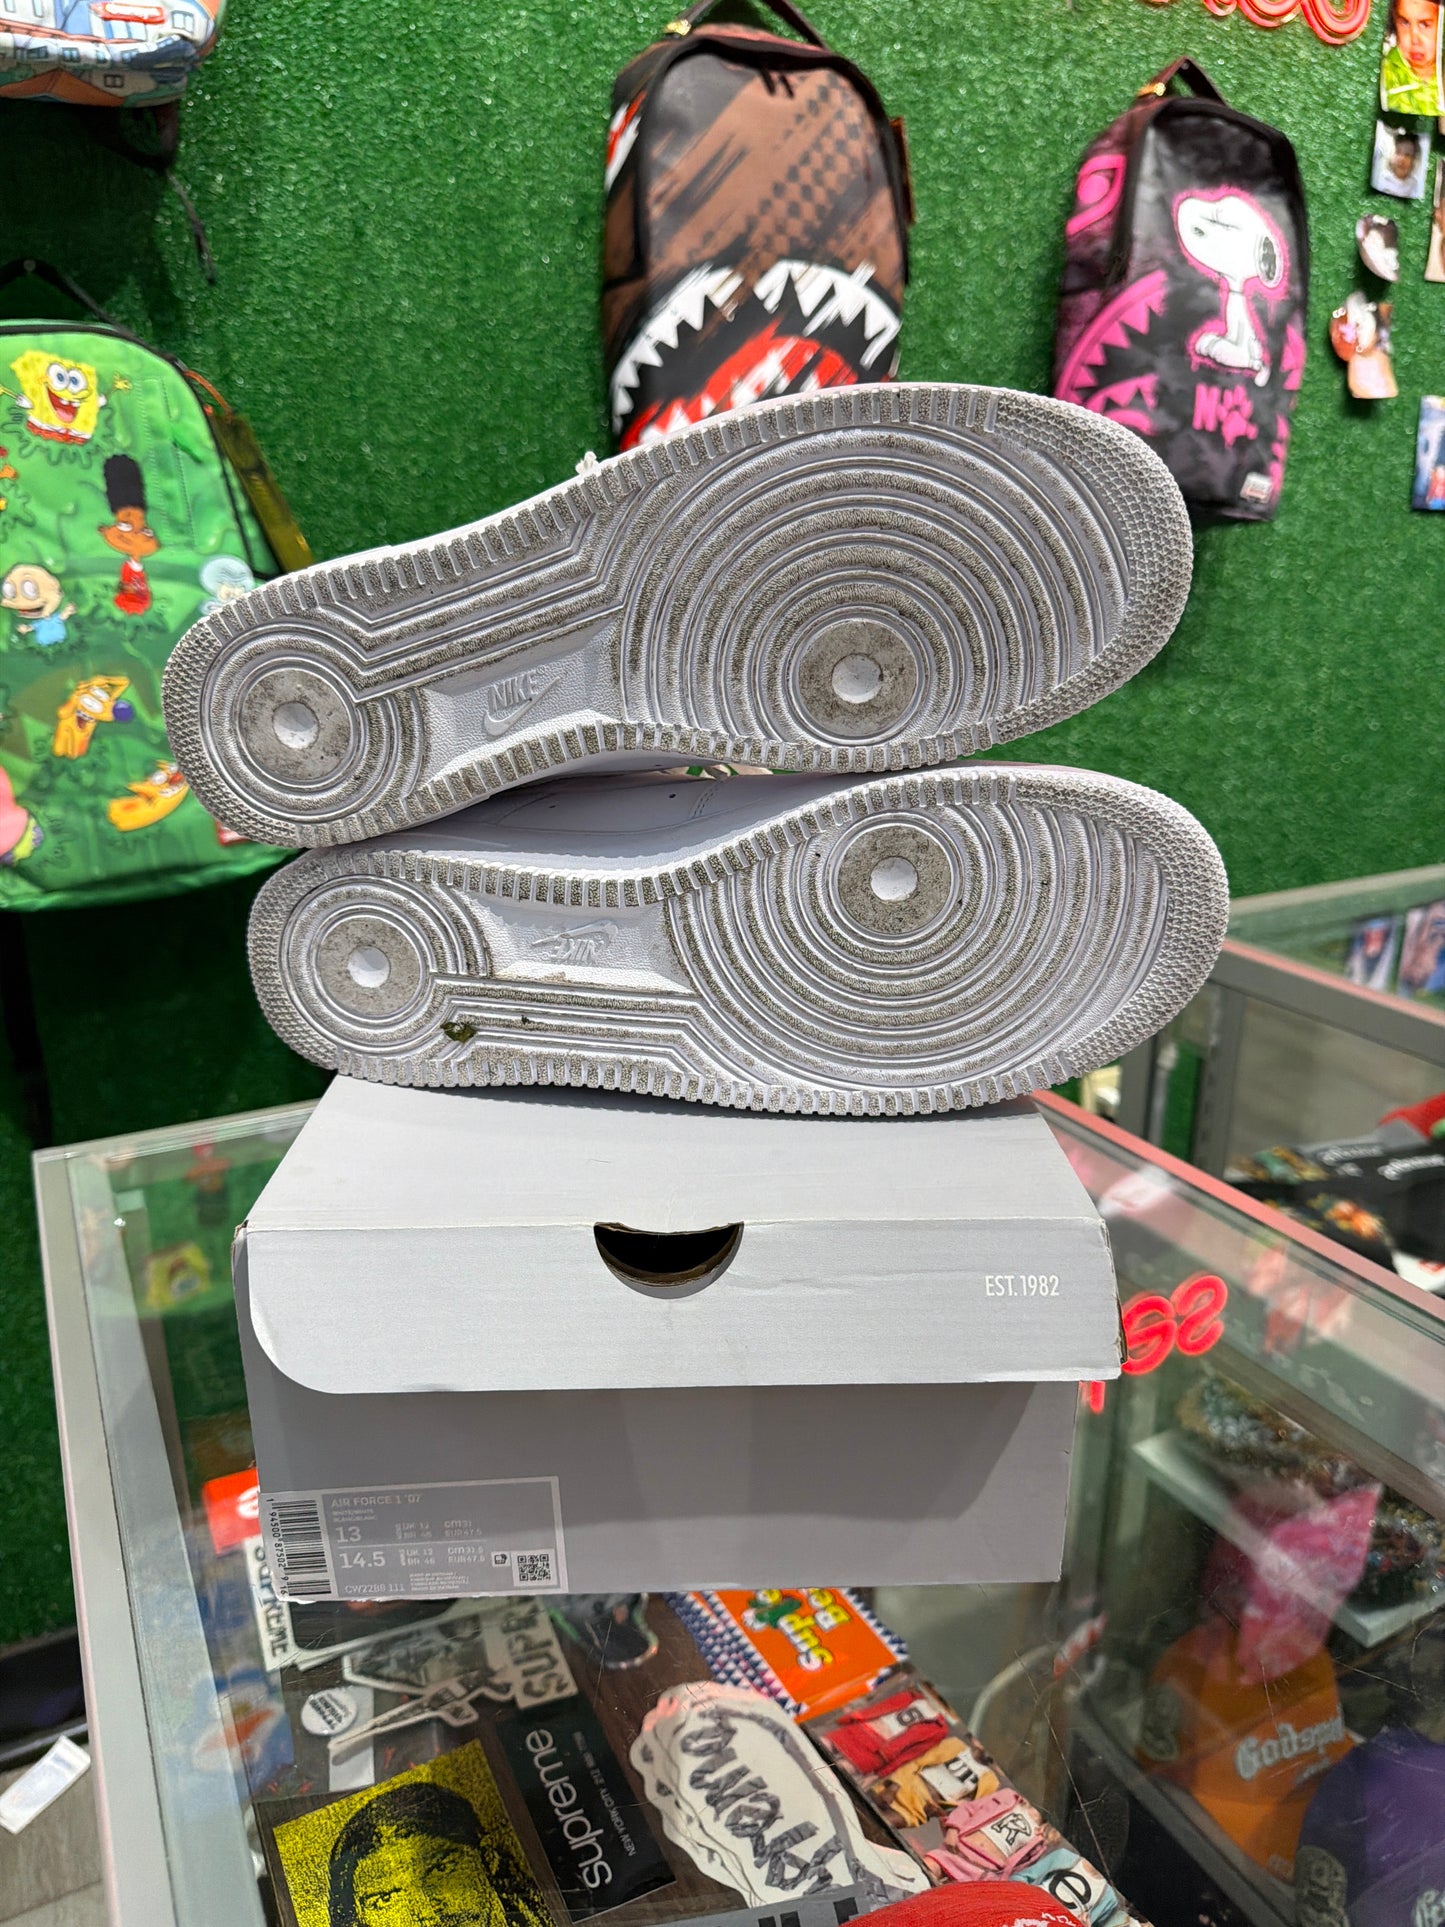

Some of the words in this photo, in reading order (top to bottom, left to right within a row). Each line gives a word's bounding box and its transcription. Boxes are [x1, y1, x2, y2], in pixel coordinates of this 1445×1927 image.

[489, 670, 539, 714] NIKE
[331, 1497, 351, 1508] AIR
[354, 1495, 393, 1506] FORCE
[396, 1495, 402, 1504] 1
[270, 1511, 281, 1538] 94500
[336, 1526, 362, 1543] 13
[274, 1543, 285, 1568] 87502
[339, 1551, 386, 1569] 14.5
[280, 1586, 288, 1595] 16
[525, 1728, 612, 1890] supreme
[607, 1806, 628, 1834] YORK
[619, 1832, 639, 1857] NEW
[990, 1812, 1033, 1846] R
[1047, 1869, 1092, 1910] e
